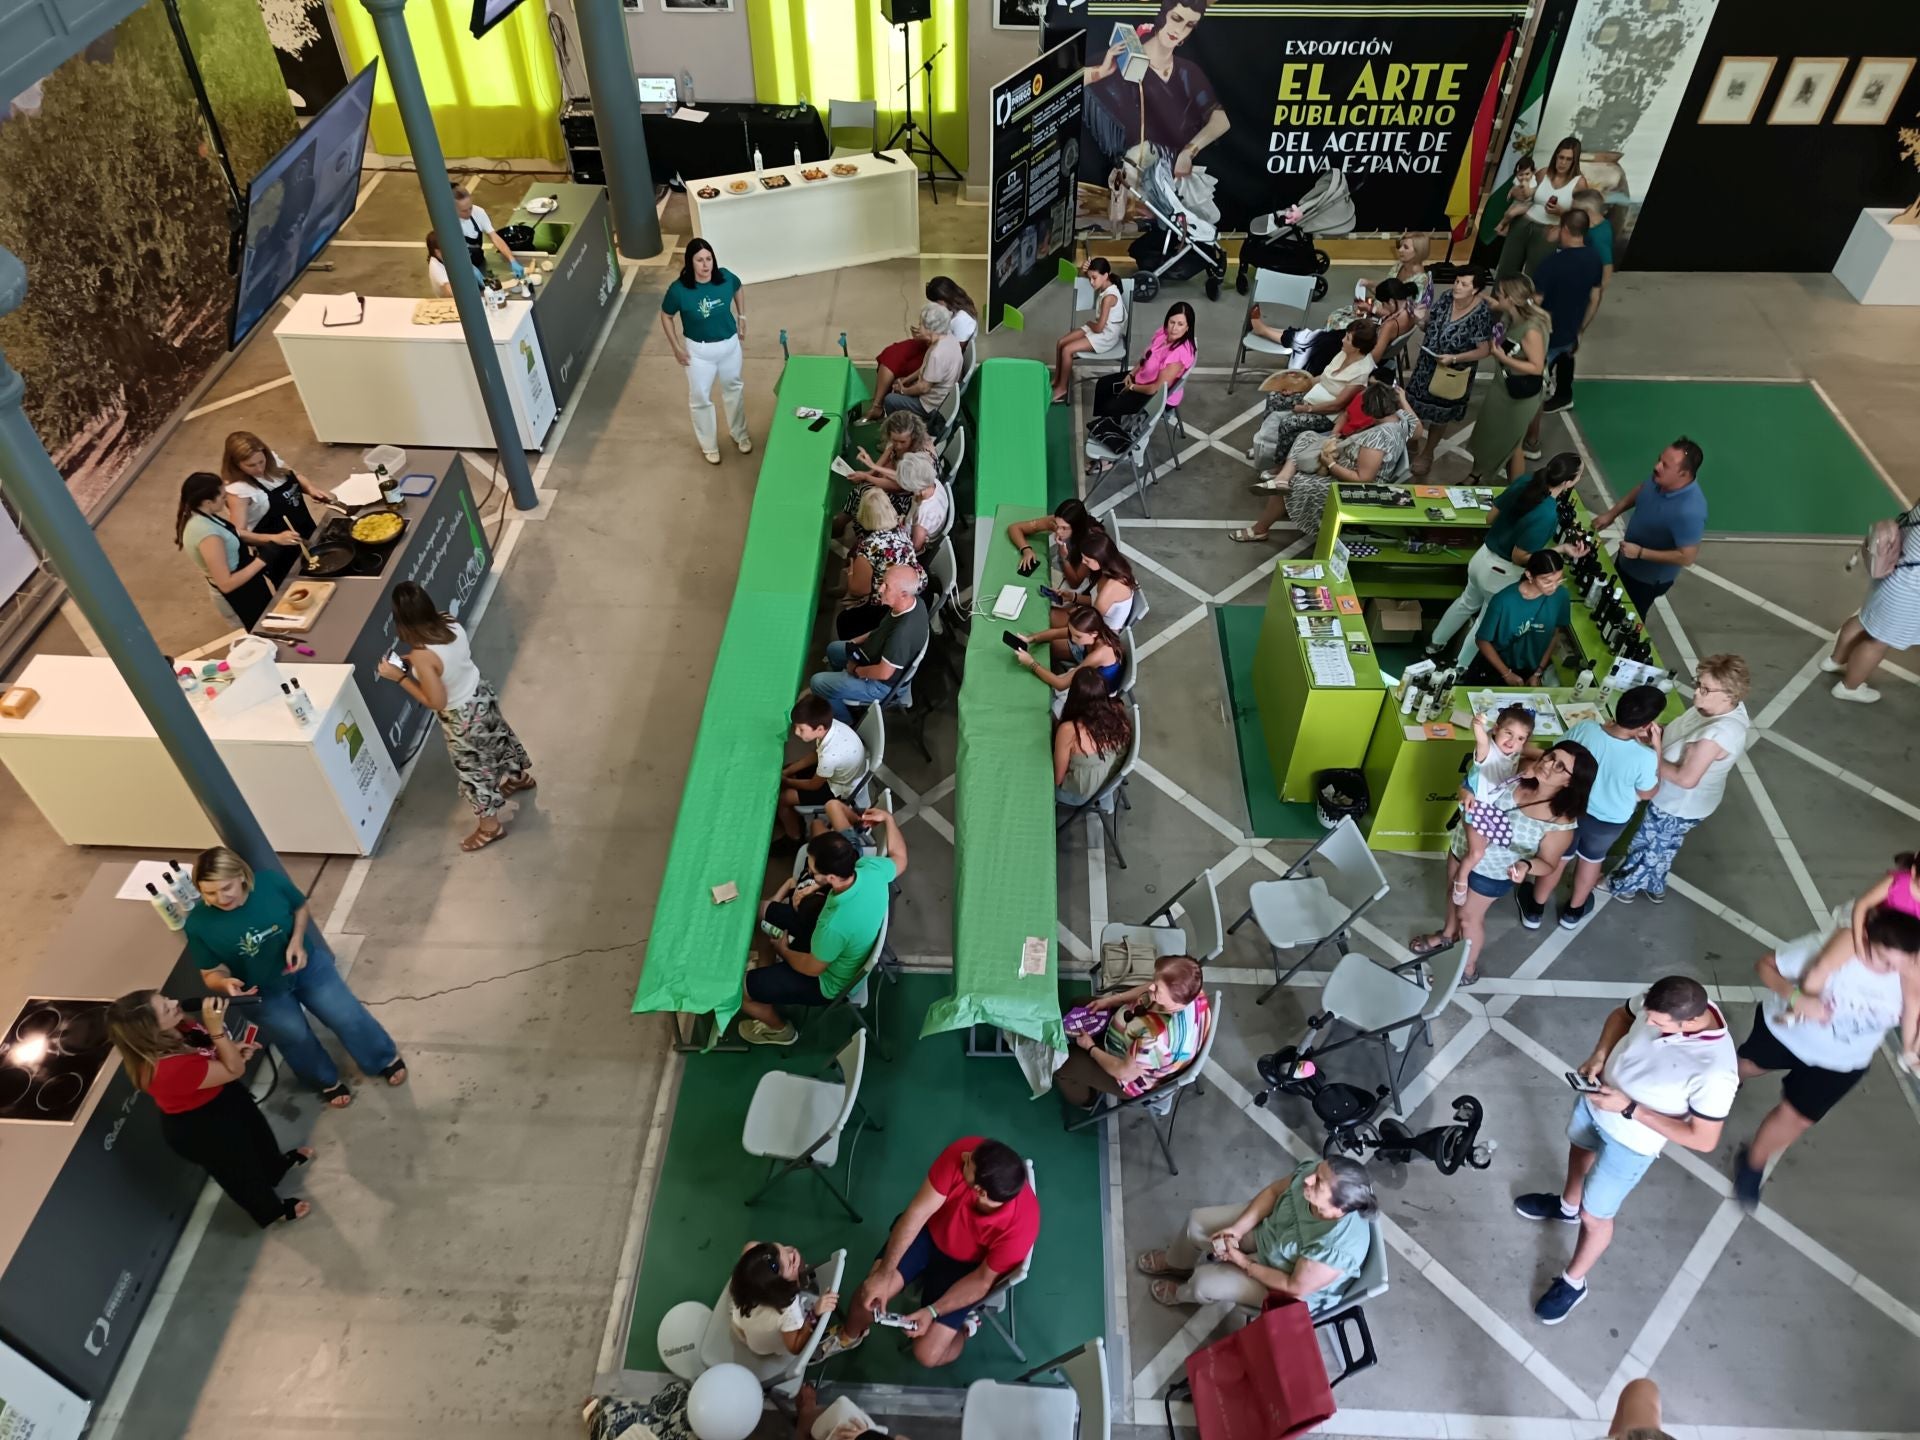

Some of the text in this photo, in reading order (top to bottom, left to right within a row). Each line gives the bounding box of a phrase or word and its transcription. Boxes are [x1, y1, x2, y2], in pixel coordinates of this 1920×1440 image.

[1285, 37, 1393, 55] EXPOSICIÓN
[1277, 59, 1468, 101] EL ARTE
[1273, 103, 1456, 126] PUBLICITARIO
[1269, 131, 1452, 152] DEL ACEITE DE
[1266, 150, 1443, 174] OLIVA ESPAÑOL
